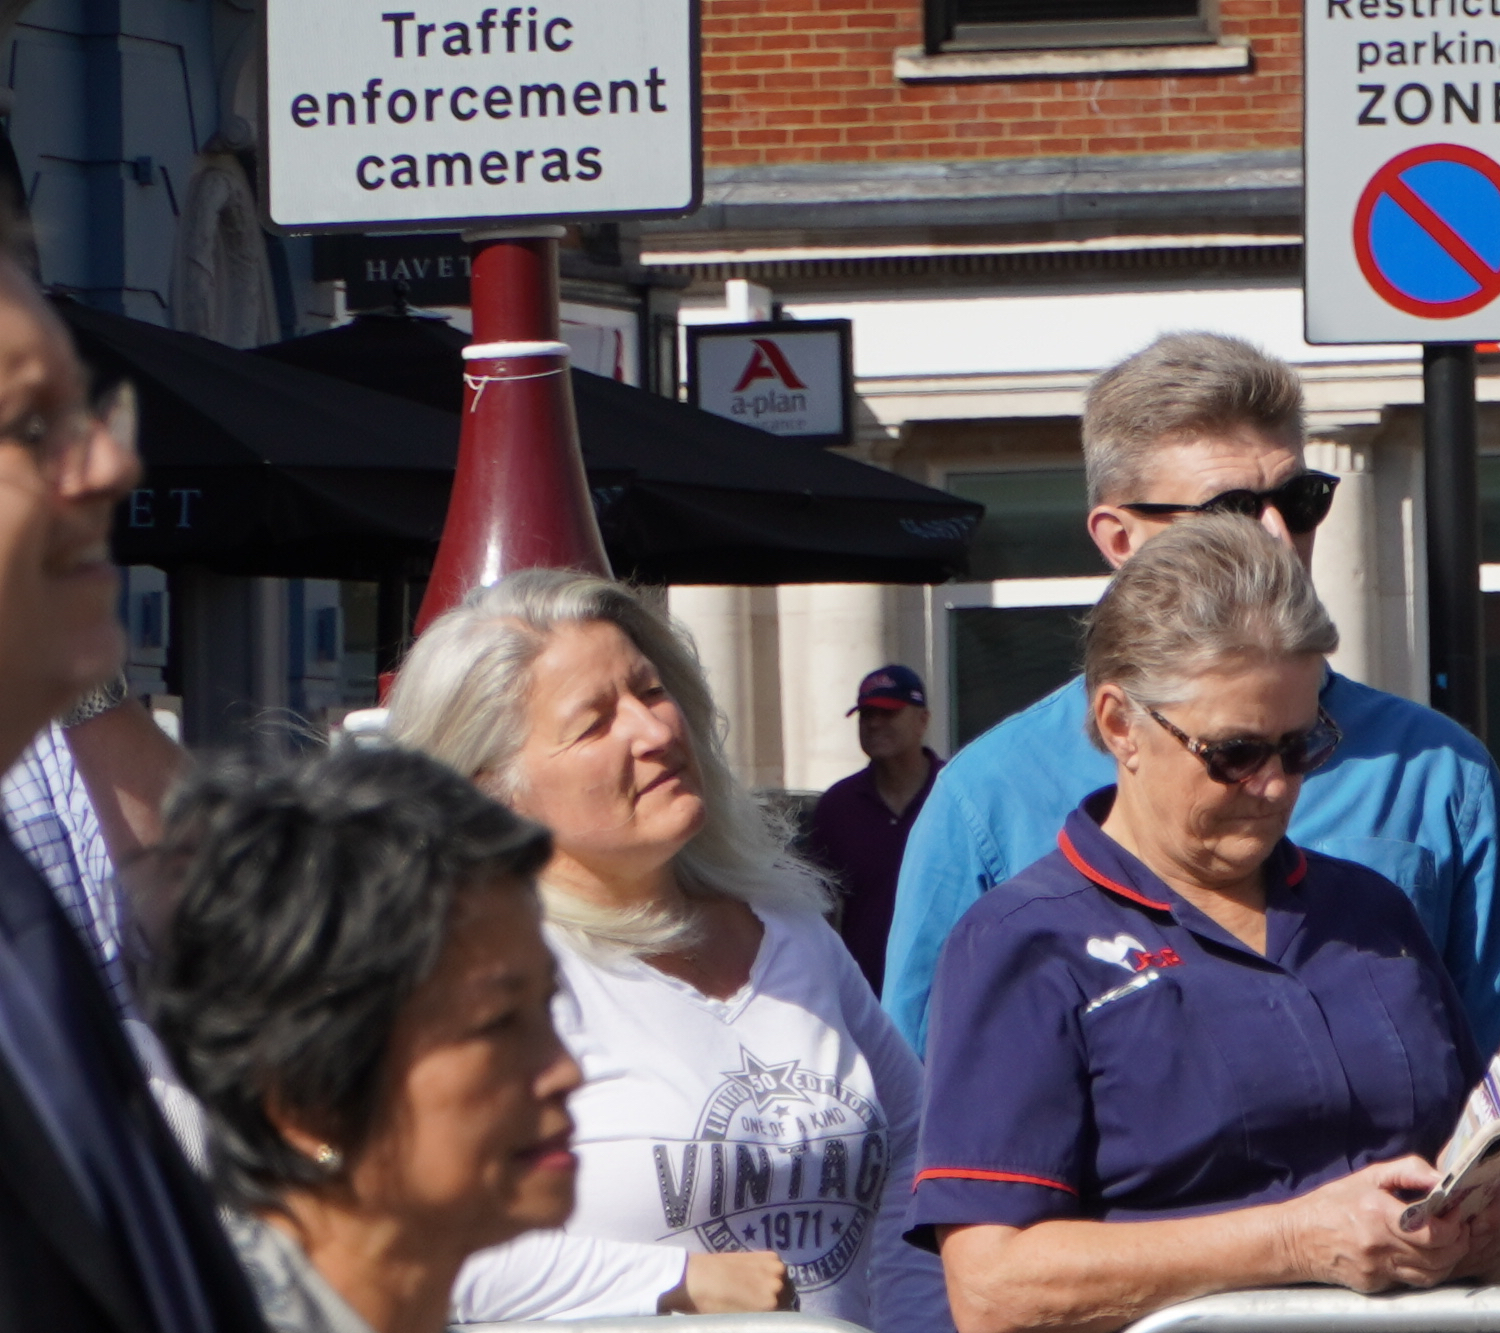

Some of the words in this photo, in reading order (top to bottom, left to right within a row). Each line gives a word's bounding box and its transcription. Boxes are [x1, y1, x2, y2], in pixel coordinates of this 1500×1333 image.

[381, 7, 574, 58] Traffic
[290, 67, 668, 128] enforcement
[356, 145, 604, 190] cameras
[730, 391, 808, 417] a-plan
[705, 1083, 750, 1135] LIMITED
[749, 1072, 776, 1093] 50
[792, 1073, 874, 1123] EDITION
[740, 1115, 766, 1134] ONE
[769, 1121, 787, 1138] OF
[796, 1114, 808, 1134] A
[810, 1106, 847, 1130] KIND
[653, 1131, 888, 1229] VINTAG
[760, 1209, 823, 1251] 1971
[786, 1211, 868, 1286] PERFECTION
